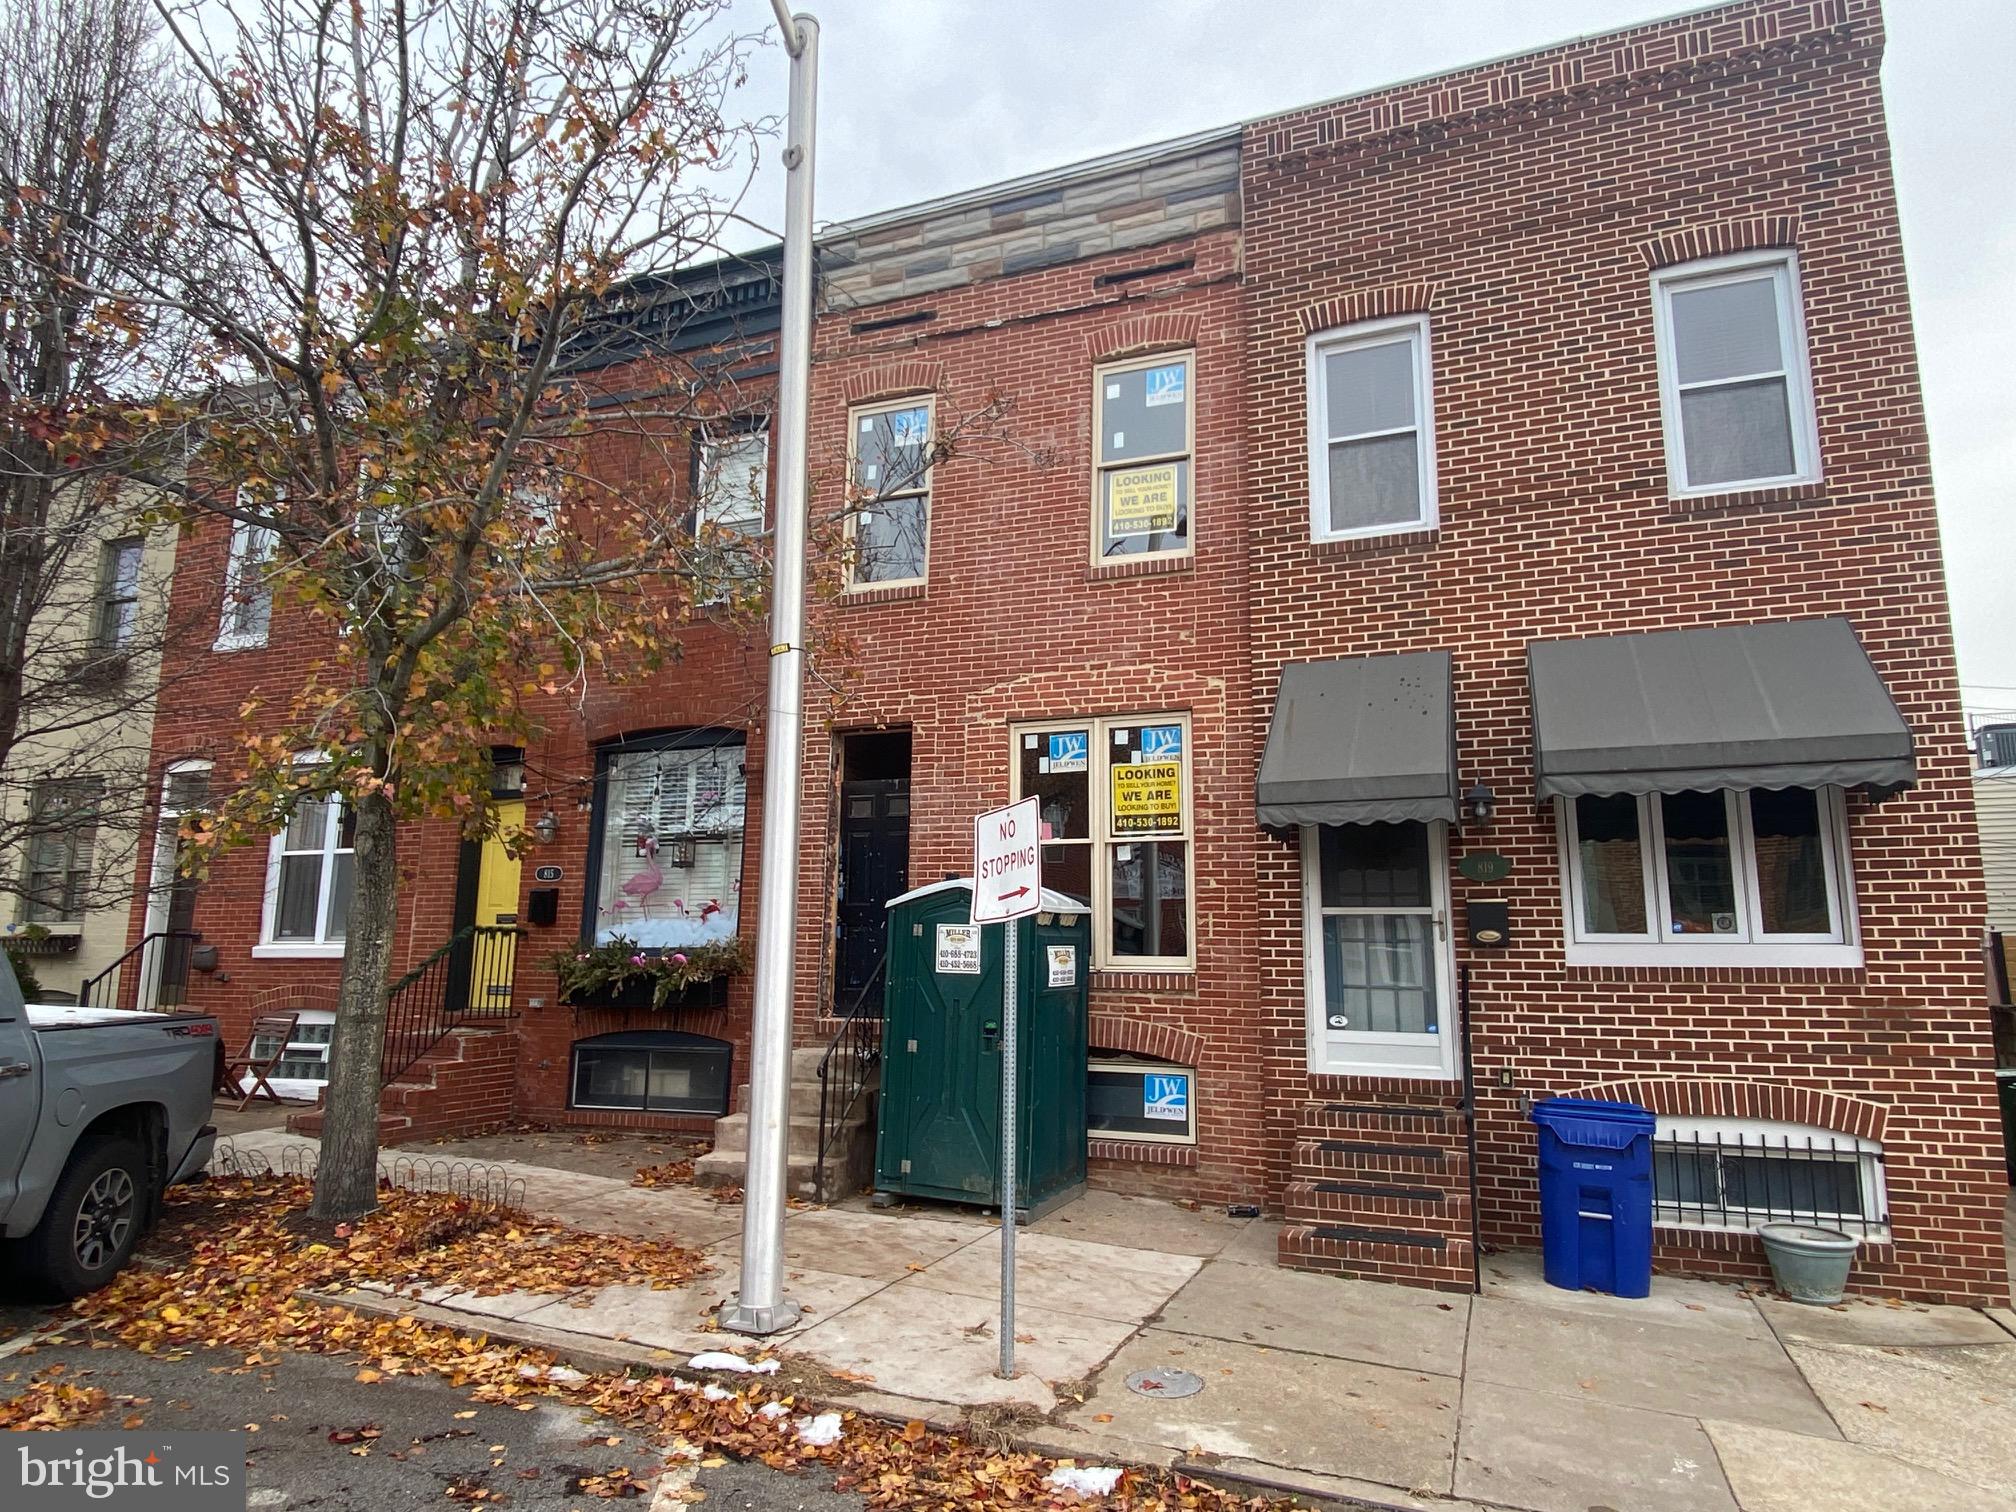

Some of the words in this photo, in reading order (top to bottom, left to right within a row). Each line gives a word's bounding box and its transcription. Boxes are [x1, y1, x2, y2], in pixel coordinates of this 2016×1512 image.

[1116, 471, 1171, 487] LOOKING
[1120, 496, 1139, 506] WE
[1143, 492, 1167, 504] ARE
[1115, 507, 1145, 517] LOOKING
[1053, 735, 1084, 759] JW
[1146, 729, 1177, 752] JW
[1117, 767, 1176, 780] LOOKING
[1122, 791, 1142, 801] WE
[1147, 789, 1172, 800] ARE
[1116, 816, 1179, 828] 410-530-1892
[1000, 820, 1016, 841] NO
[982, 846, 1035, 879] STOPPING
[1477, 862, 1494, 873] 819
[543, 869, 554, 879] 815
[946, 929, 971, 938] MILLER
[1149, 1077, 1182, 1102] JW
